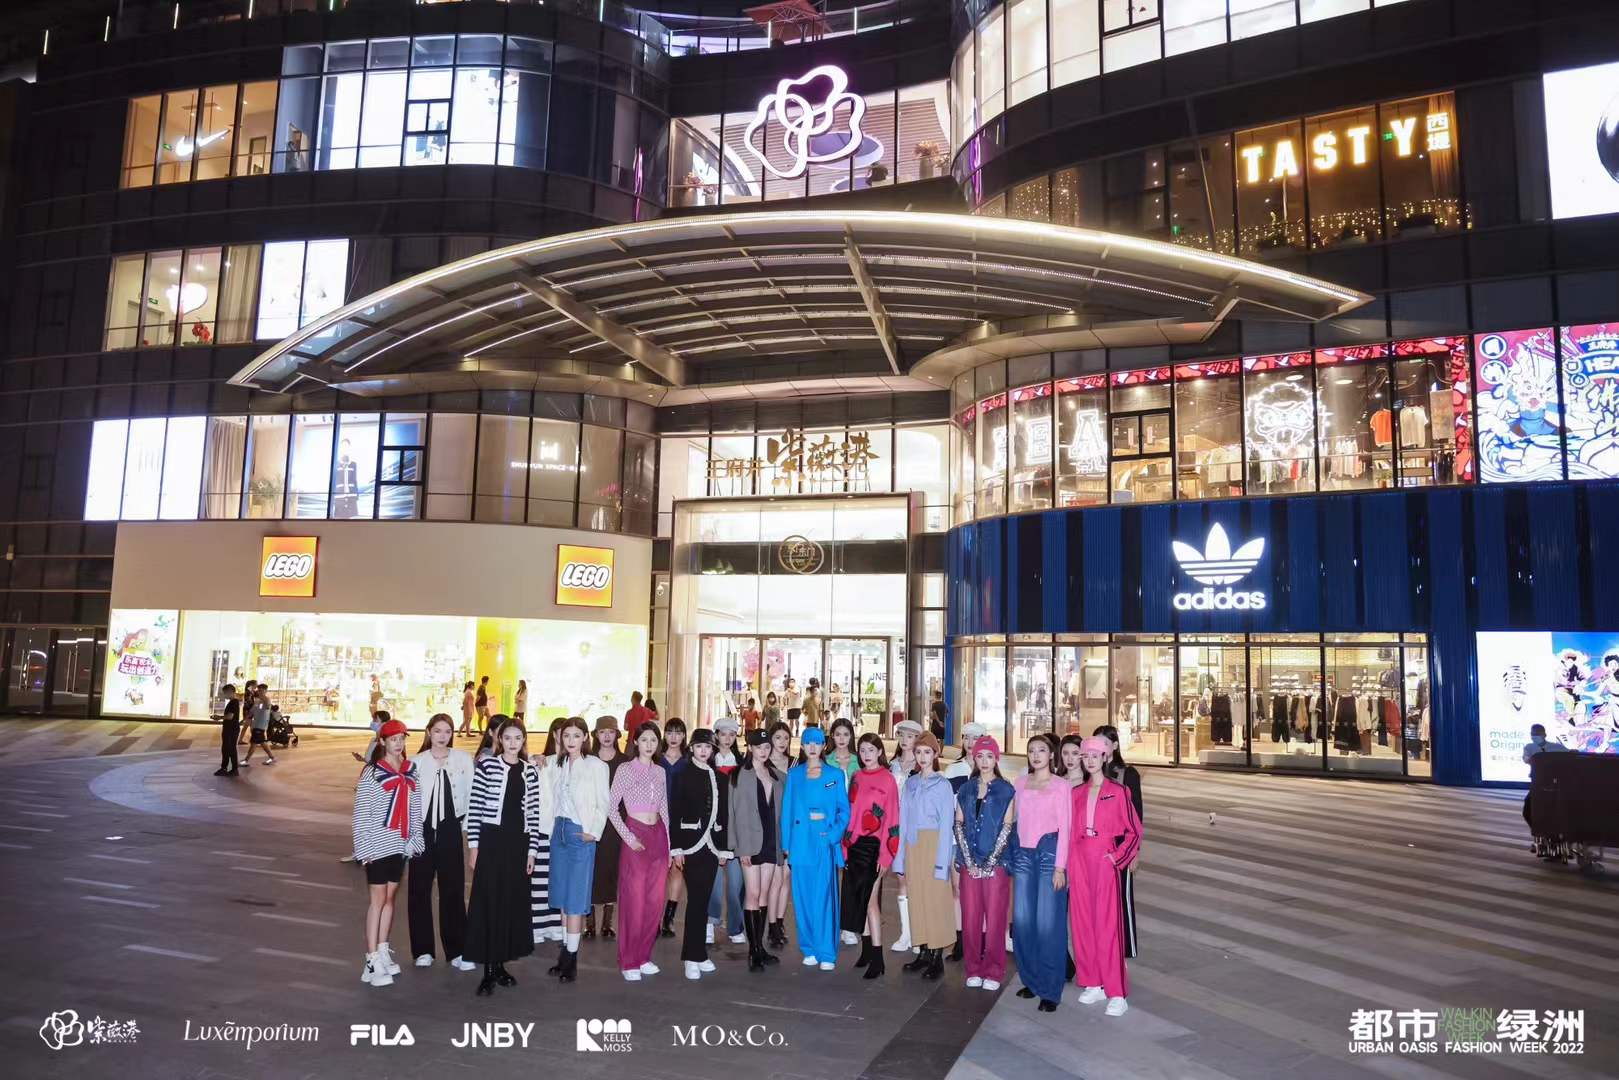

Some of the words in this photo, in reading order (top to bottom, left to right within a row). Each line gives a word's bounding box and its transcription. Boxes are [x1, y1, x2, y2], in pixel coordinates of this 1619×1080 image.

[1242, 117, 1416, 183] TASTY
[705, 457, 764, 479] 王府井
[264, 554, 313, 578] LEGO
[561, 563, 610, 589] LEGO
[1173, 587, 1266, 610] adidas
